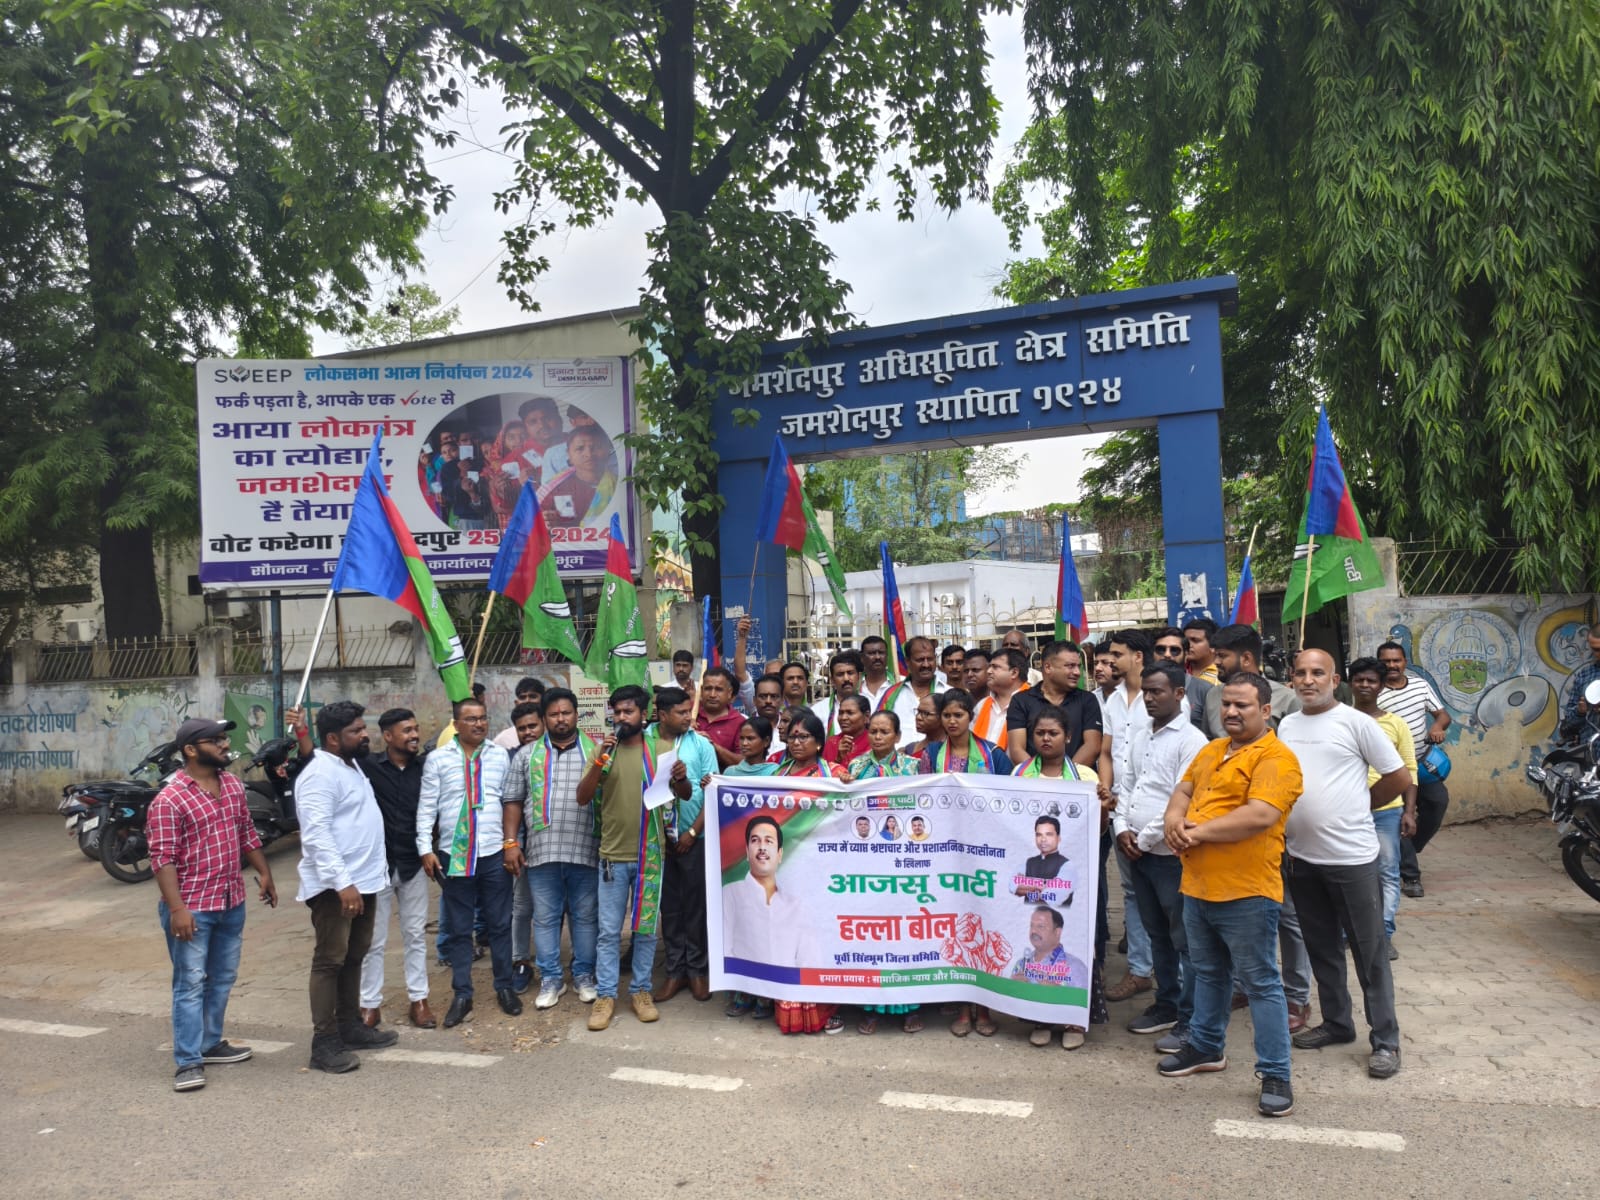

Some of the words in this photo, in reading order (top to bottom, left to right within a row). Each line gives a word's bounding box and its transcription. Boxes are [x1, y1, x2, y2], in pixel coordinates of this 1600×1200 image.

[859, 340, 999, 384] अधिसूचित
[1015, 329, 1067, 363] क्षेत्र
[1085, 311, 1191, 353] समिति
[304, 364, 379, 382] लोकसभा
[384, 366, 421, 381] आम
[425, 362, 488, 381] निर्वाचन
[492, 365, 533, 380] 2024
[215, 392, 250, 409] फर्क
[253, 394, 294, 411] पड़ता
[297, 390, 312, 409] है,
[316, 391, 364, 407] आपके
[367, 394, 396, 407] एक
[400, 390, 436, 406] Vote
[440, 389, 456, 405] से
[781, 402, 903, 439] जमशेदपुर
[917, 385, 1021, 425] स्थापित
[1033, 377, 1122, 412] १९२४
[212, 421, 292, 439] आया
[298, 415, 416, 438] लोकतंत्र
[233, 449, 276, 467] का
[260, 500, 284, 522] है
[290, 499, 355, 522] तैया
[209, 534, 252, 553] वोट
[259, 532, 333, 552] करेगा
[468, 529, 499, 545] 25
[251, 564, 308, 577] सौजन्य
[40, 701, 77, 733] शोषण
[817, 842, 837, 853] राज्य
[839, 840, 849, 853] में
[904, 840, 920, 854] और
[922, 839, 965, 854] प्रशासनिक
[966, 843, 1006, 859] उदासीनता
[894, 857, 903, 868] के
[903, 857, 931, 869] खिलाफ
[827, 873, 937, 904] आजसू
[937, 869, 998, 898] पार्टी
[837, 914, 903, 941] हल्ला
[905, 907, 958, 940] बोल
[834, 952, 850, 965] पूर्वी
[852, 952, 884, 965] सिंहभूम
[885, 952, 910, 963] जिला
[912, 951, 940, 962] समिति
[872, 973, 910, 983] सामाजिक
[932, 971, 948, 982] और
